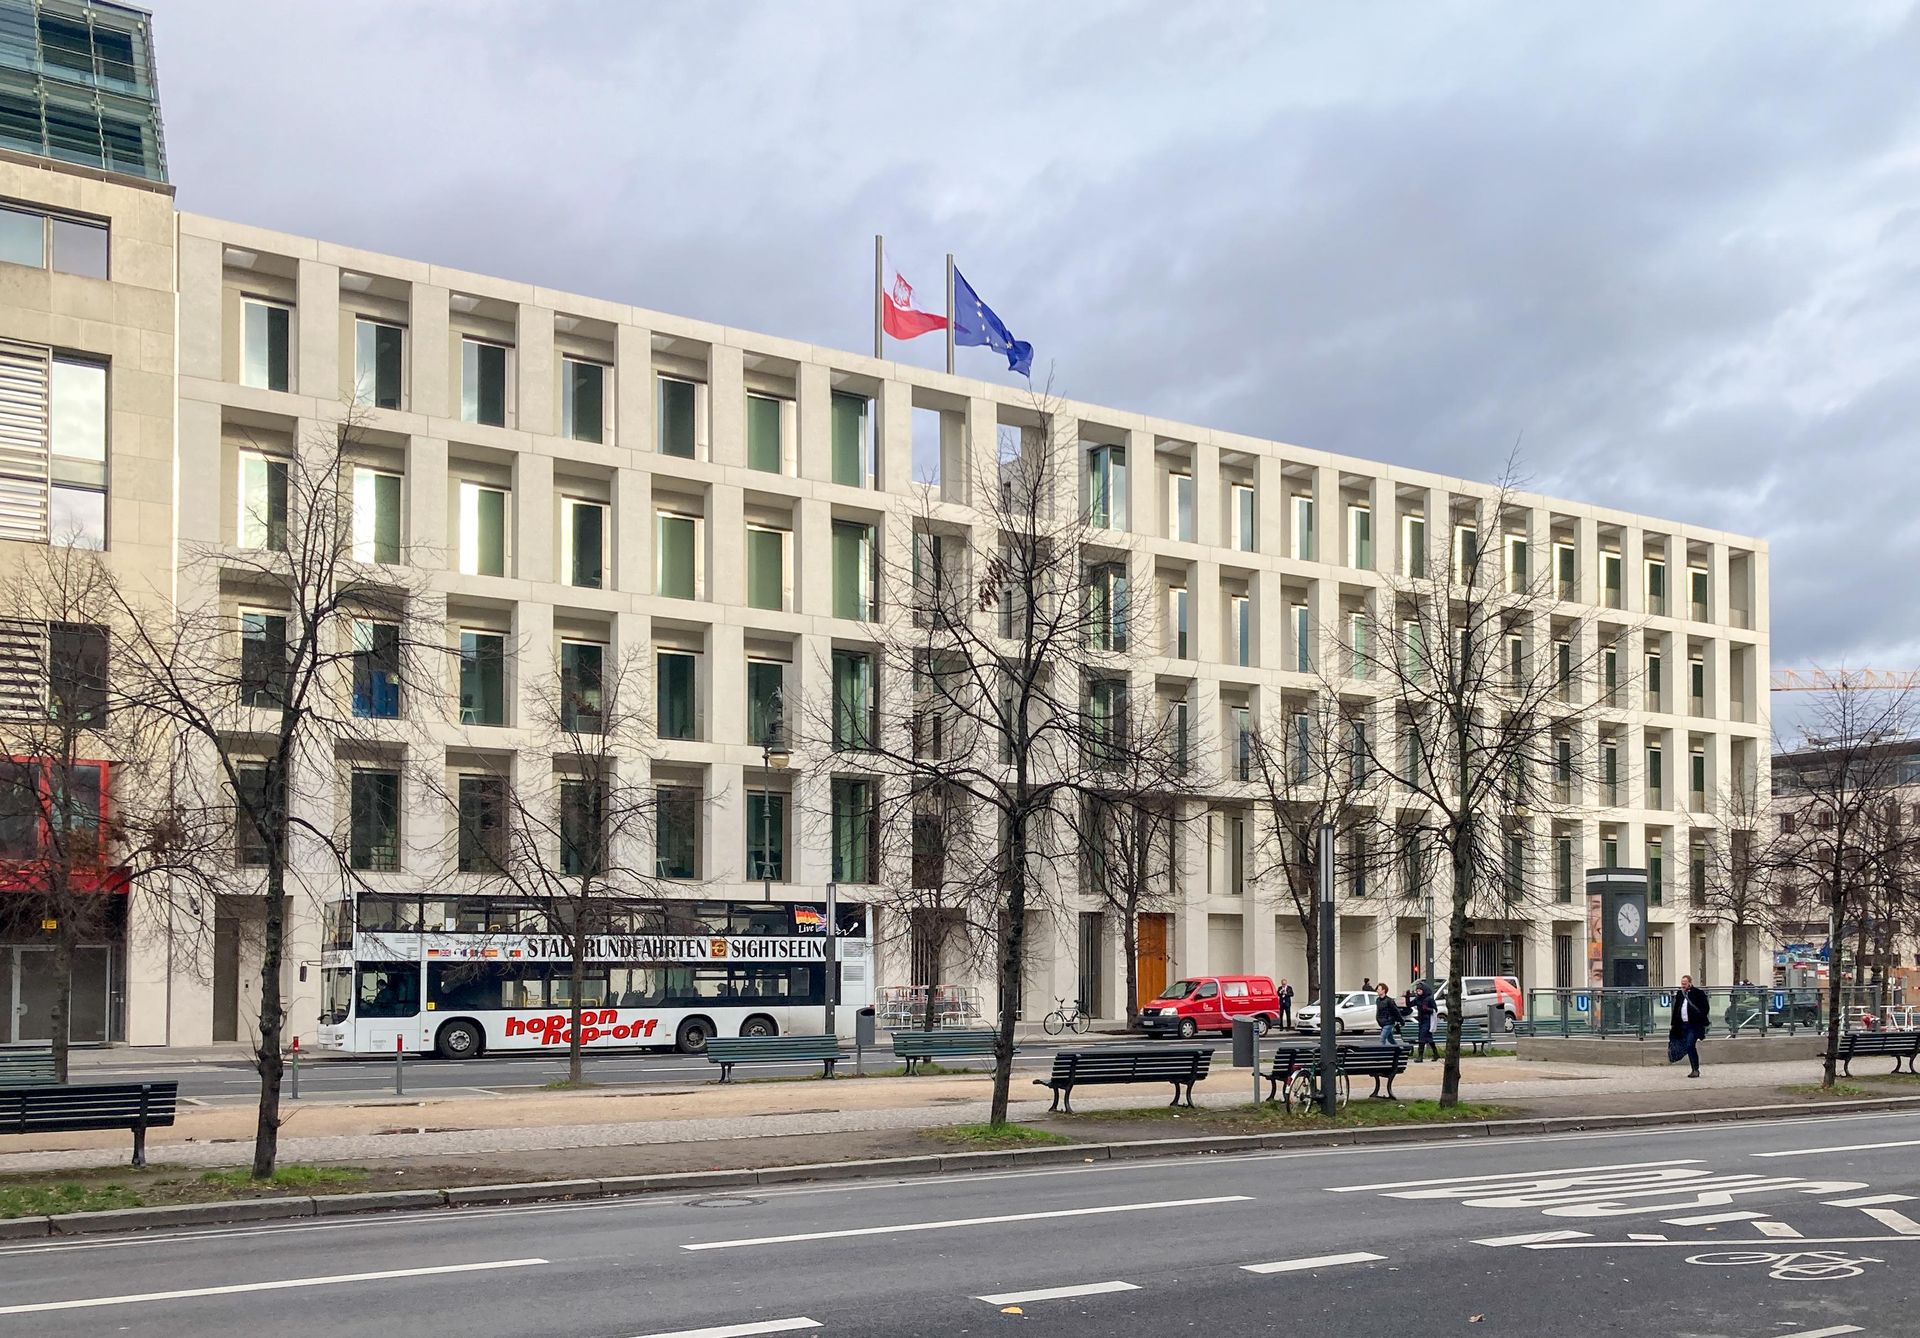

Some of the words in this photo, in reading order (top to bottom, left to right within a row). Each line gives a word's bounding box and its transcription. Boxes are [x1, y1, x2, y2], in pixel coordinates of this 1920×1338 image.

[798, 925, 815, 934] Live
[1578, 996, 1588, 1011] U
[1775, 995, 1784, 1010] U
[541, 1018, 660, 1046] hop-off
[1378, 1168, 1870, 1217] BUS
